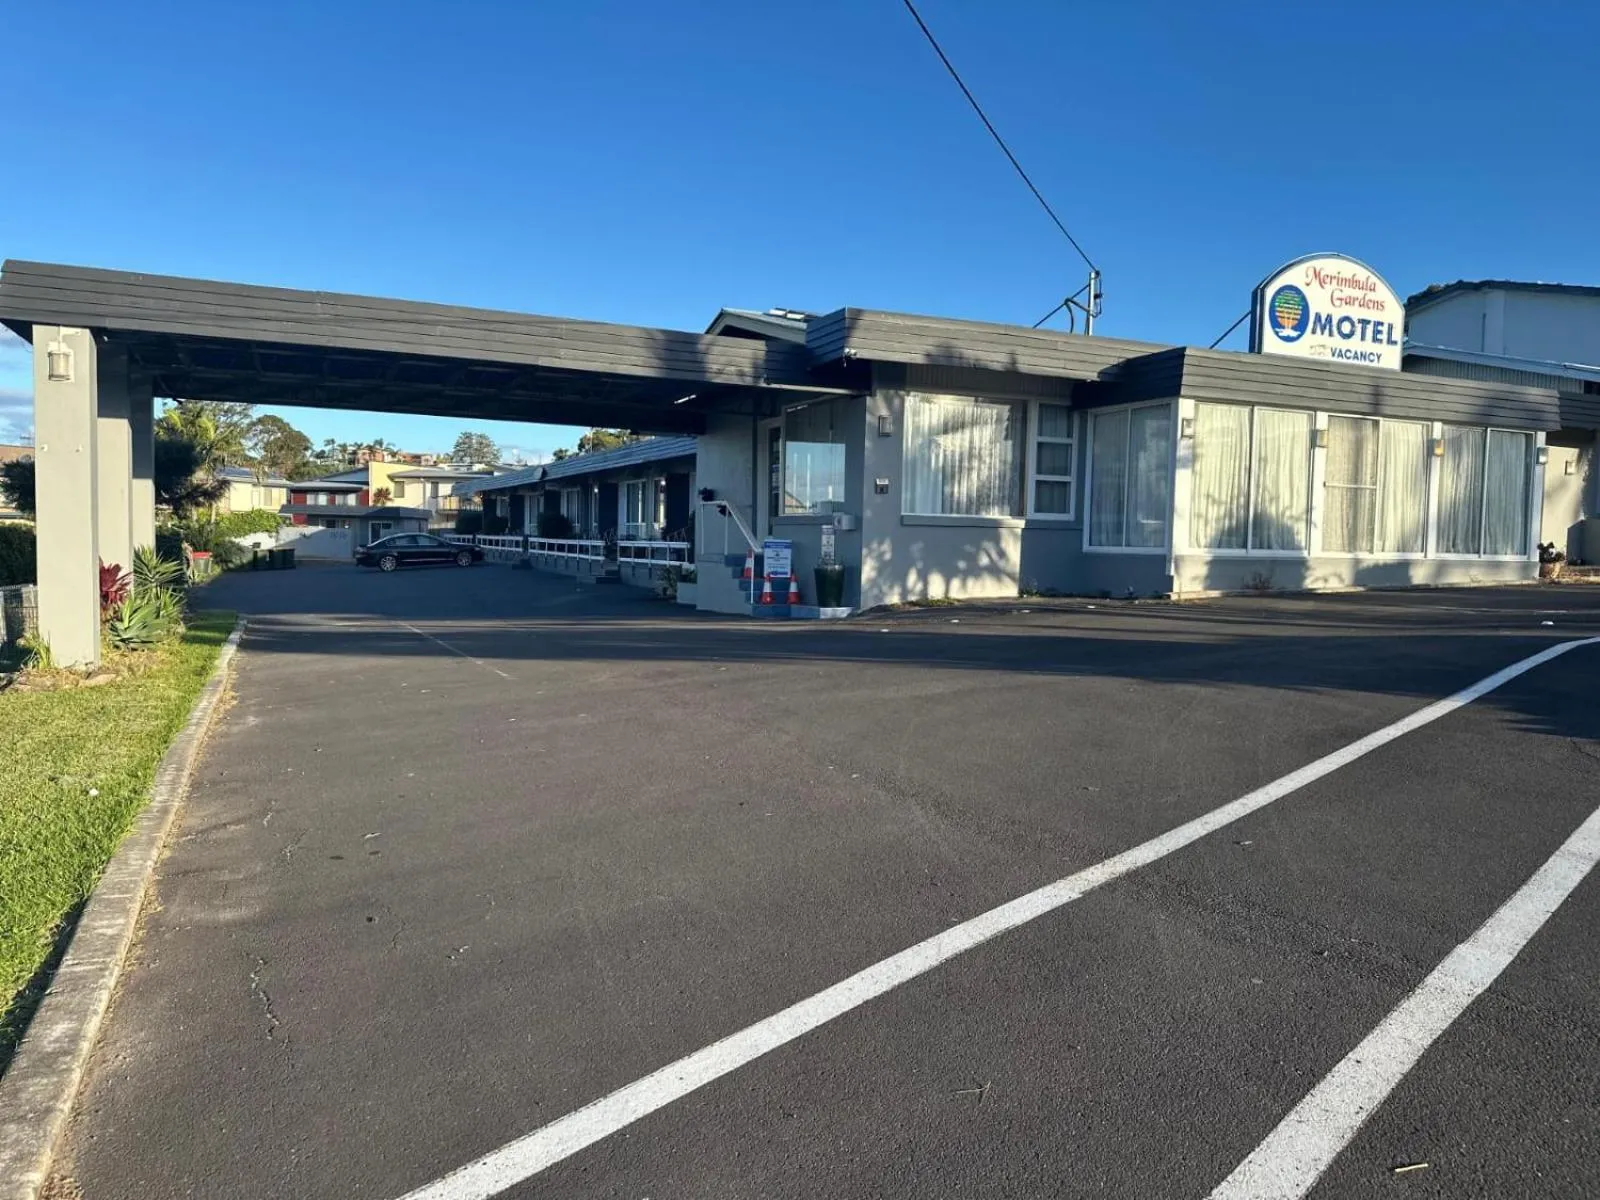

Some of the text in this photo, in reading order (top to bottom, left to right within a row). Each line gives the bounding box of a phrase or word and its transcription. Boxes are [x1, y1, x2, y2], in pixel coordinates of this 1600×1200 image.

[1304, 265, 1377, 293] Merimbula
[1330, 288, 1385, 312] Gardens
[1311, 312, 1398, 346] MOTEL
[1330, 347, 1383, 364] VACANCY
